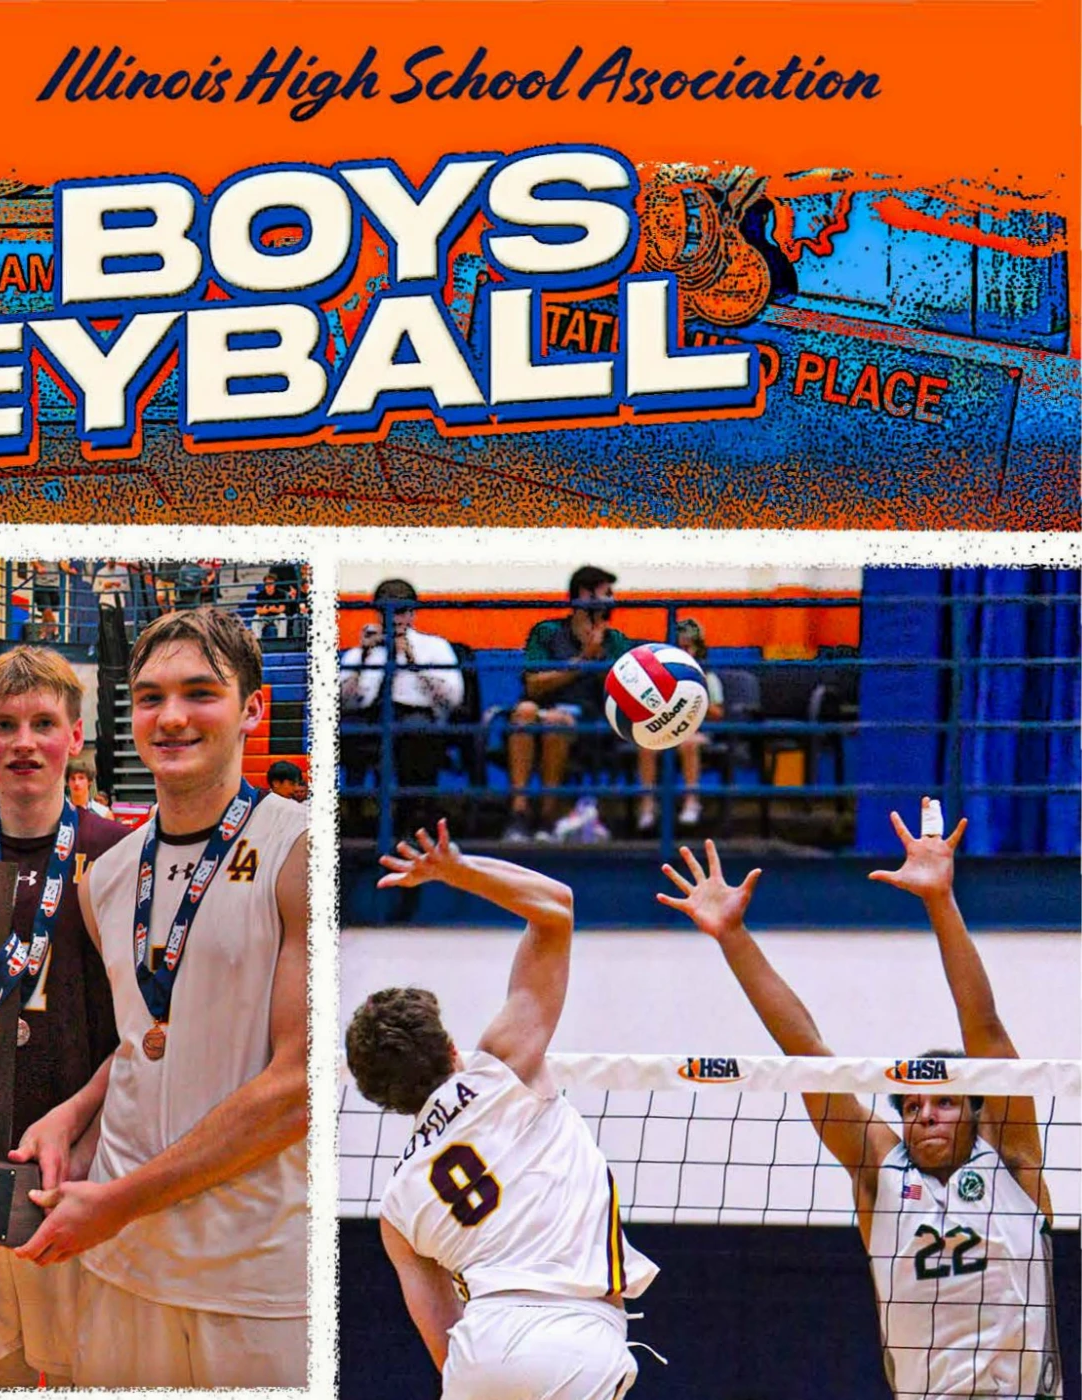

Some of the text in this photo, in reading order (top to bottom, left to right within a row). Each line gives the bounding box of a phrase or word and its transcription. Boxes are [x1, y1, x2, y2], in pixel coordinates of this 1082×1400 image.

[36, 45, 883, 122] Illinois High School Association
[62, 151, 633, 304] BOYS
[545, 303, 619, 353] TAT
[794, 351, 949, 424] PLACE
[645, 697, 688, 733] Wilson
[227, 839, 259, 882] LA
[687, 1057, 740, 1078] IHSA
[895, 1060, 948, 1080] IHSA
[429, 1141, 503, 1228] 8
[914, 1224, 988, 1281] 22
